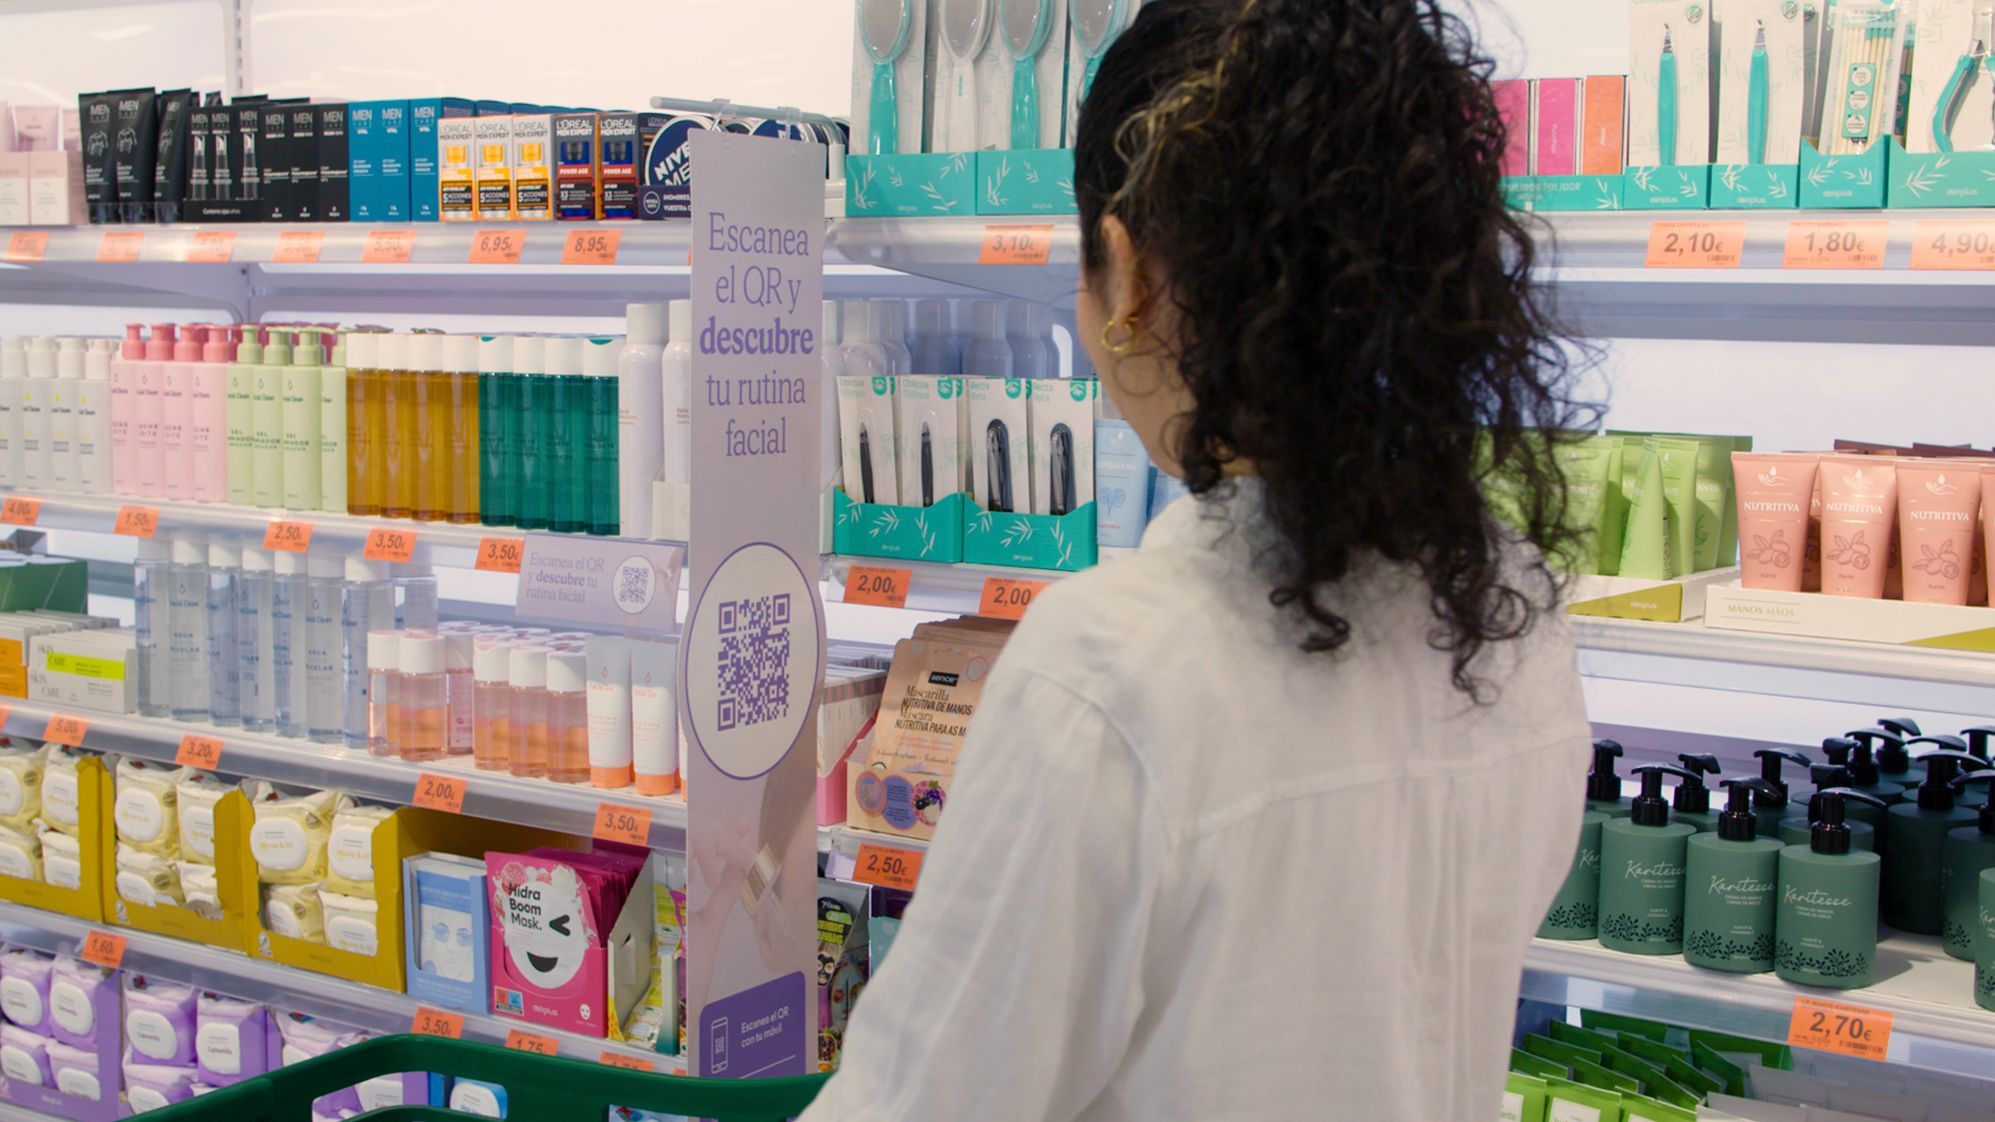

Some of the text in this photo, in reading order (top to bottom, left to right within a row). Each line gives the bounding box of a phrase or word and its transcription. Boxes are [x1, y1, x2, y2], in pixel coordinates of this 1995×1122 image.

[266, 114, 285, 125] MEN
[294, 112, 313, 123] MEN
[324, 112, 343, 122] MEN
[352, 110, 372, 121] MEN
[382, 108, 402, 119] MEN
[414, 106, 435, 118] MEN
[570, 128, 592, 136] EXPERT
[614, 128, 635, 136] EXPERT
[654, 140, 690, 181] NIVE
[665, 163, 690, 186] ME
[709, 212, 809, 256] Escanea
[992, 235, 1035, 251] 3,10€
[1664, 232, 1722, 254] 2,10€
[1804, 231, 1864, 254] 1,80€
[481, 237, 512, 252] 6,95€
[575, 238, 607, 254] 8,95€
[716, 265, 802, 314] el QR y
[700, 316, 813, 355] descubre
[707, 373, 729, 405] tu
[738, 369, 806, 405] rutina
[726, 417, 787, 456] facial
[1744, 501, 1799, 512] NUTRITIVA
[1826, 501, 1883, 514] NUTRITIVA
[1910, 510, 1969, 522] NUTRITIVA
[376, 534, 405, 550] 3,50€
[488, 544, 519, 560] 3,50€
[530, 552, 605, 572] Escanea el QR
[528, 570, 598, 588] y descubre tu
[857, 575, 896, 594] 2,00€
[526, 587, 585, 603] rutina facial
[1728, 604, 1763, 615] MANOS
[907, 685, 949, 701] Mascarilla
[902, 698, 973, 716] NUTRITIVA DE MANOS
[895, 719, 928, 732] NUTRITIVA
[930, 722, 947, 735] PARA
[948, 725, 958, 736] AS
[424, 781, 456, 800] 2,00€
[605, 813, 639, 832] 3,50€
[867, 854, 909, 876] 2,50€
[508, 884, 541, 901] Hidra
[1709, 876, 1775, 895] Karitesse
[1783, 884, 1852, 906] Karitesse
[509, 898, 542, 916] Boom
[511, 912, 542, 931] Mask.
[422, 1016, 452, 1036] 3,50€
[741, 1006, 789, 1033] Escanea el QR
[1809, 1011, 1871, 1040] 2,70€
[741, 1023, 782, 1048] con tu móvil
